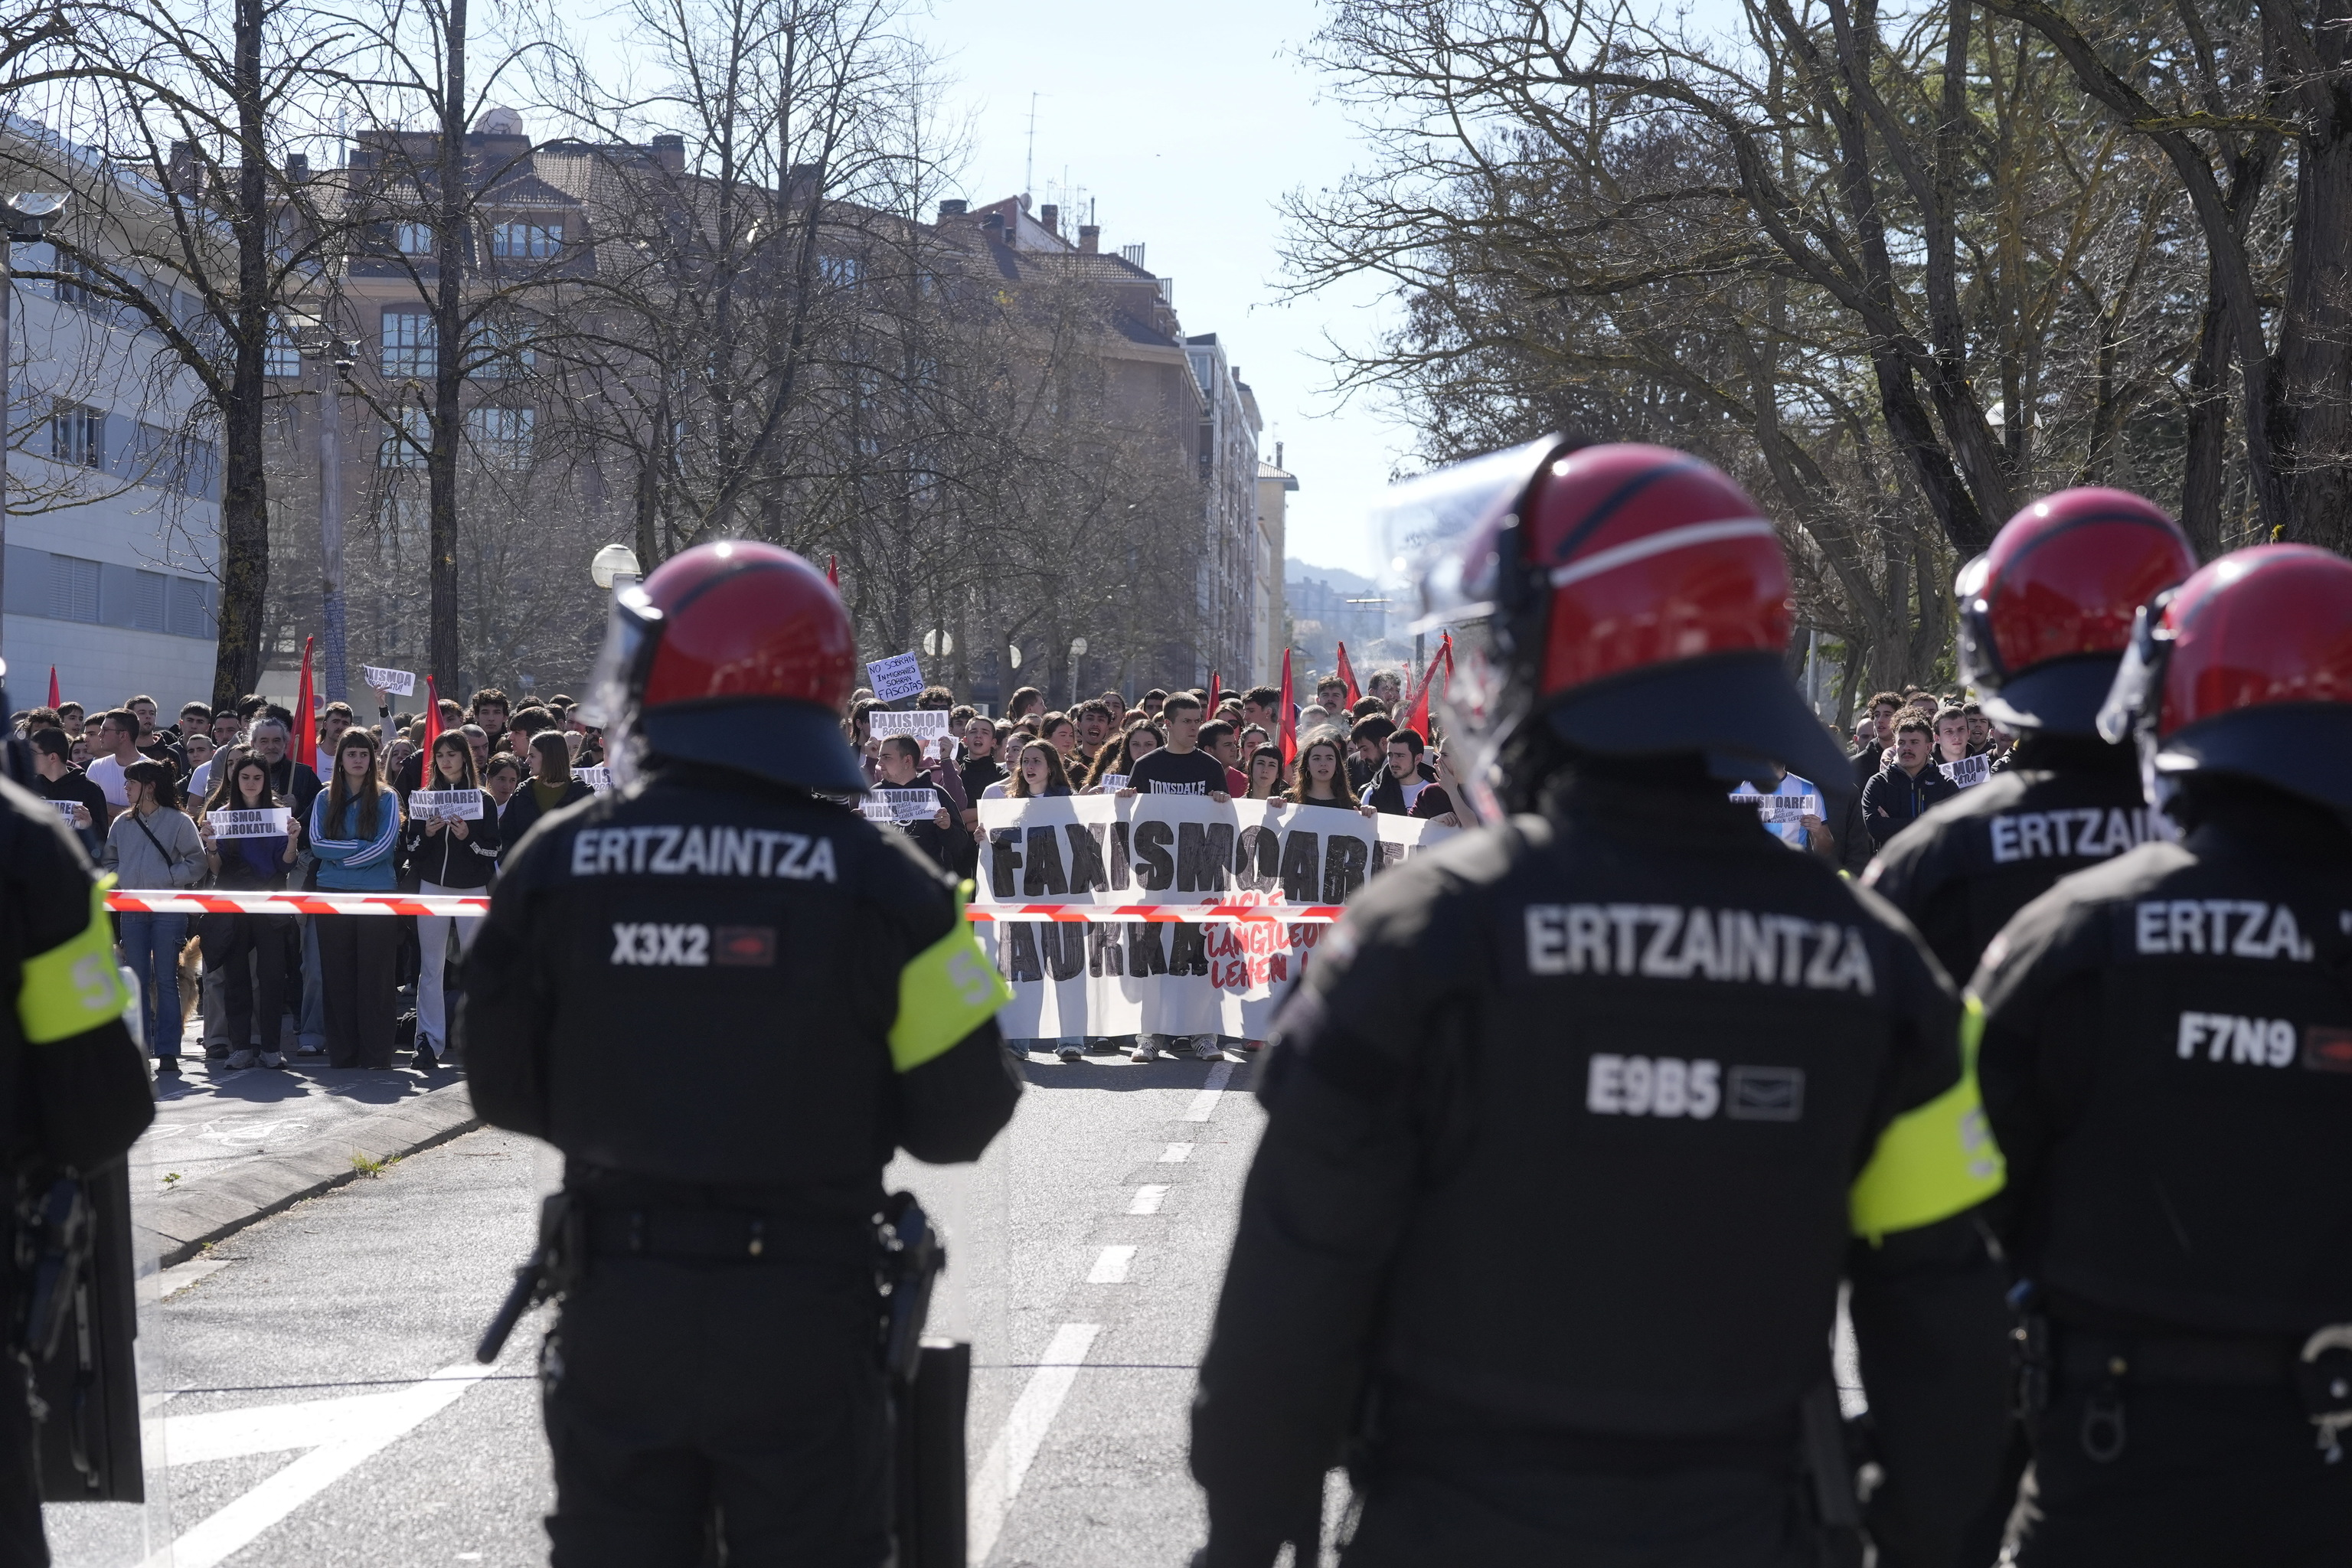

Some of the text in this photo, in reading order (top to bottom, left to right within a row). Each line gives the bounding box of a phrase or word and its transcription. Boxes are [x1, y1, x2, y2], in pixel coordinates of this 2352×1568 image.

[364, 667, 411, 686] XISMOA
[869, 655, 915, 675] NO SOBRAN
[876, 665, 916, 682] INMIGRANTES
[886, 675, 912, 687] SOBRAN
[878, 680, 923, 701] FASCISTAS
[872, 713, 946, 729] FAXISMOA
[210, 811, 262, 824] FAXISMOA
[1990, 806, 2173, 864] ERTZAI
[570, 825, 838, 884] ERTZAINTZA
[990, 821, 1426, 905] FAXISMOAR
[611, 923, 710, 967] X3X2
[998, 921, 1209, 983] AURKA
[1524, 902, 1877, 996] ERTZAINTZA
[70, 952, 116, 1011] 5
[946, 948, 993, 1006] 5
[1210, 954, 1288, 989] LEHEN
[2176, 1011, 2297, 1069] F7N9
